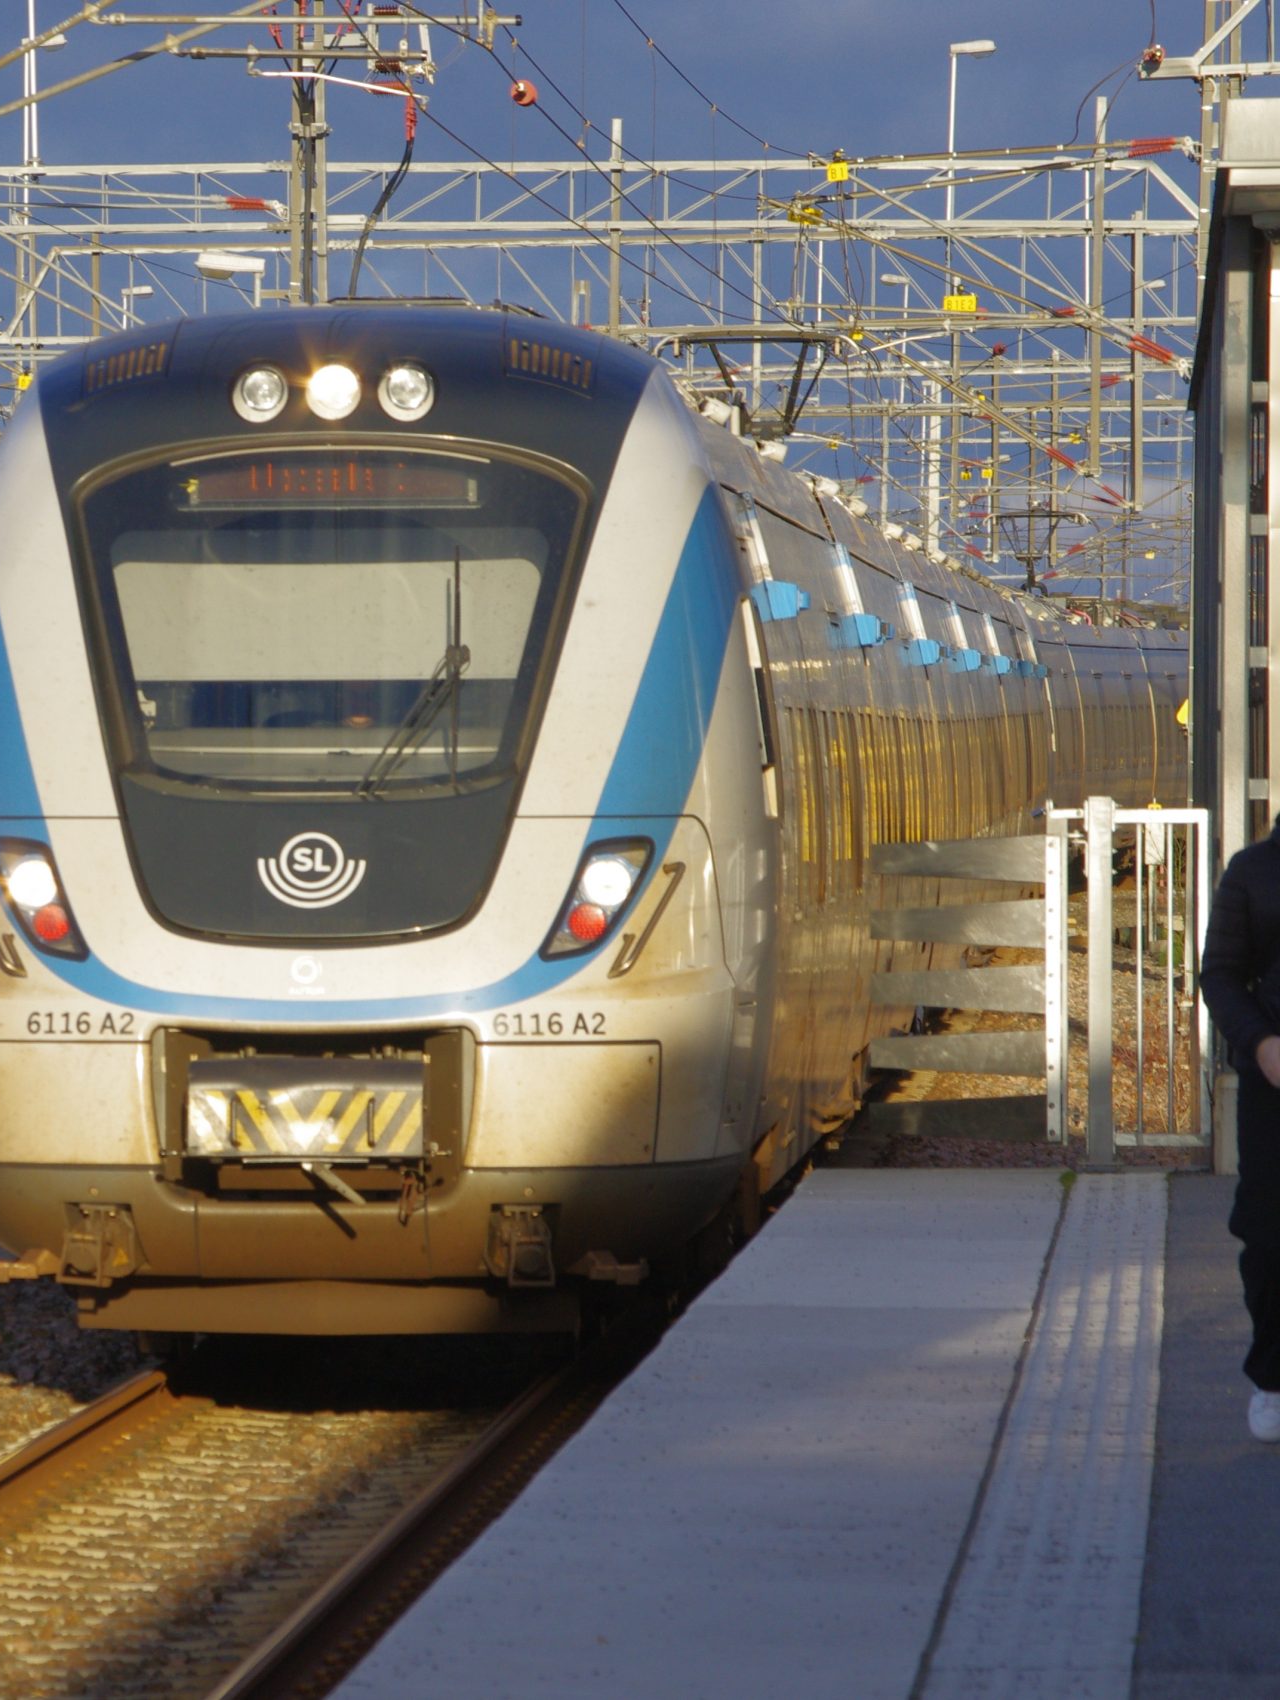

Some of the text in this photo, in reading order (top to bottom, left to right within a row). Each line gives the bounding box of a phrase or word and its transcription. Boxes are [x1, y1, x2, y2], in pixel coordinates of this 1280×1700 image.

[830, 167, 844, 179] B1
[292, 847, 331, 873] SL
[27, 1011, 135, 1034] 6116 A2
[492, 1012, 607, 1036] 6116 A2
